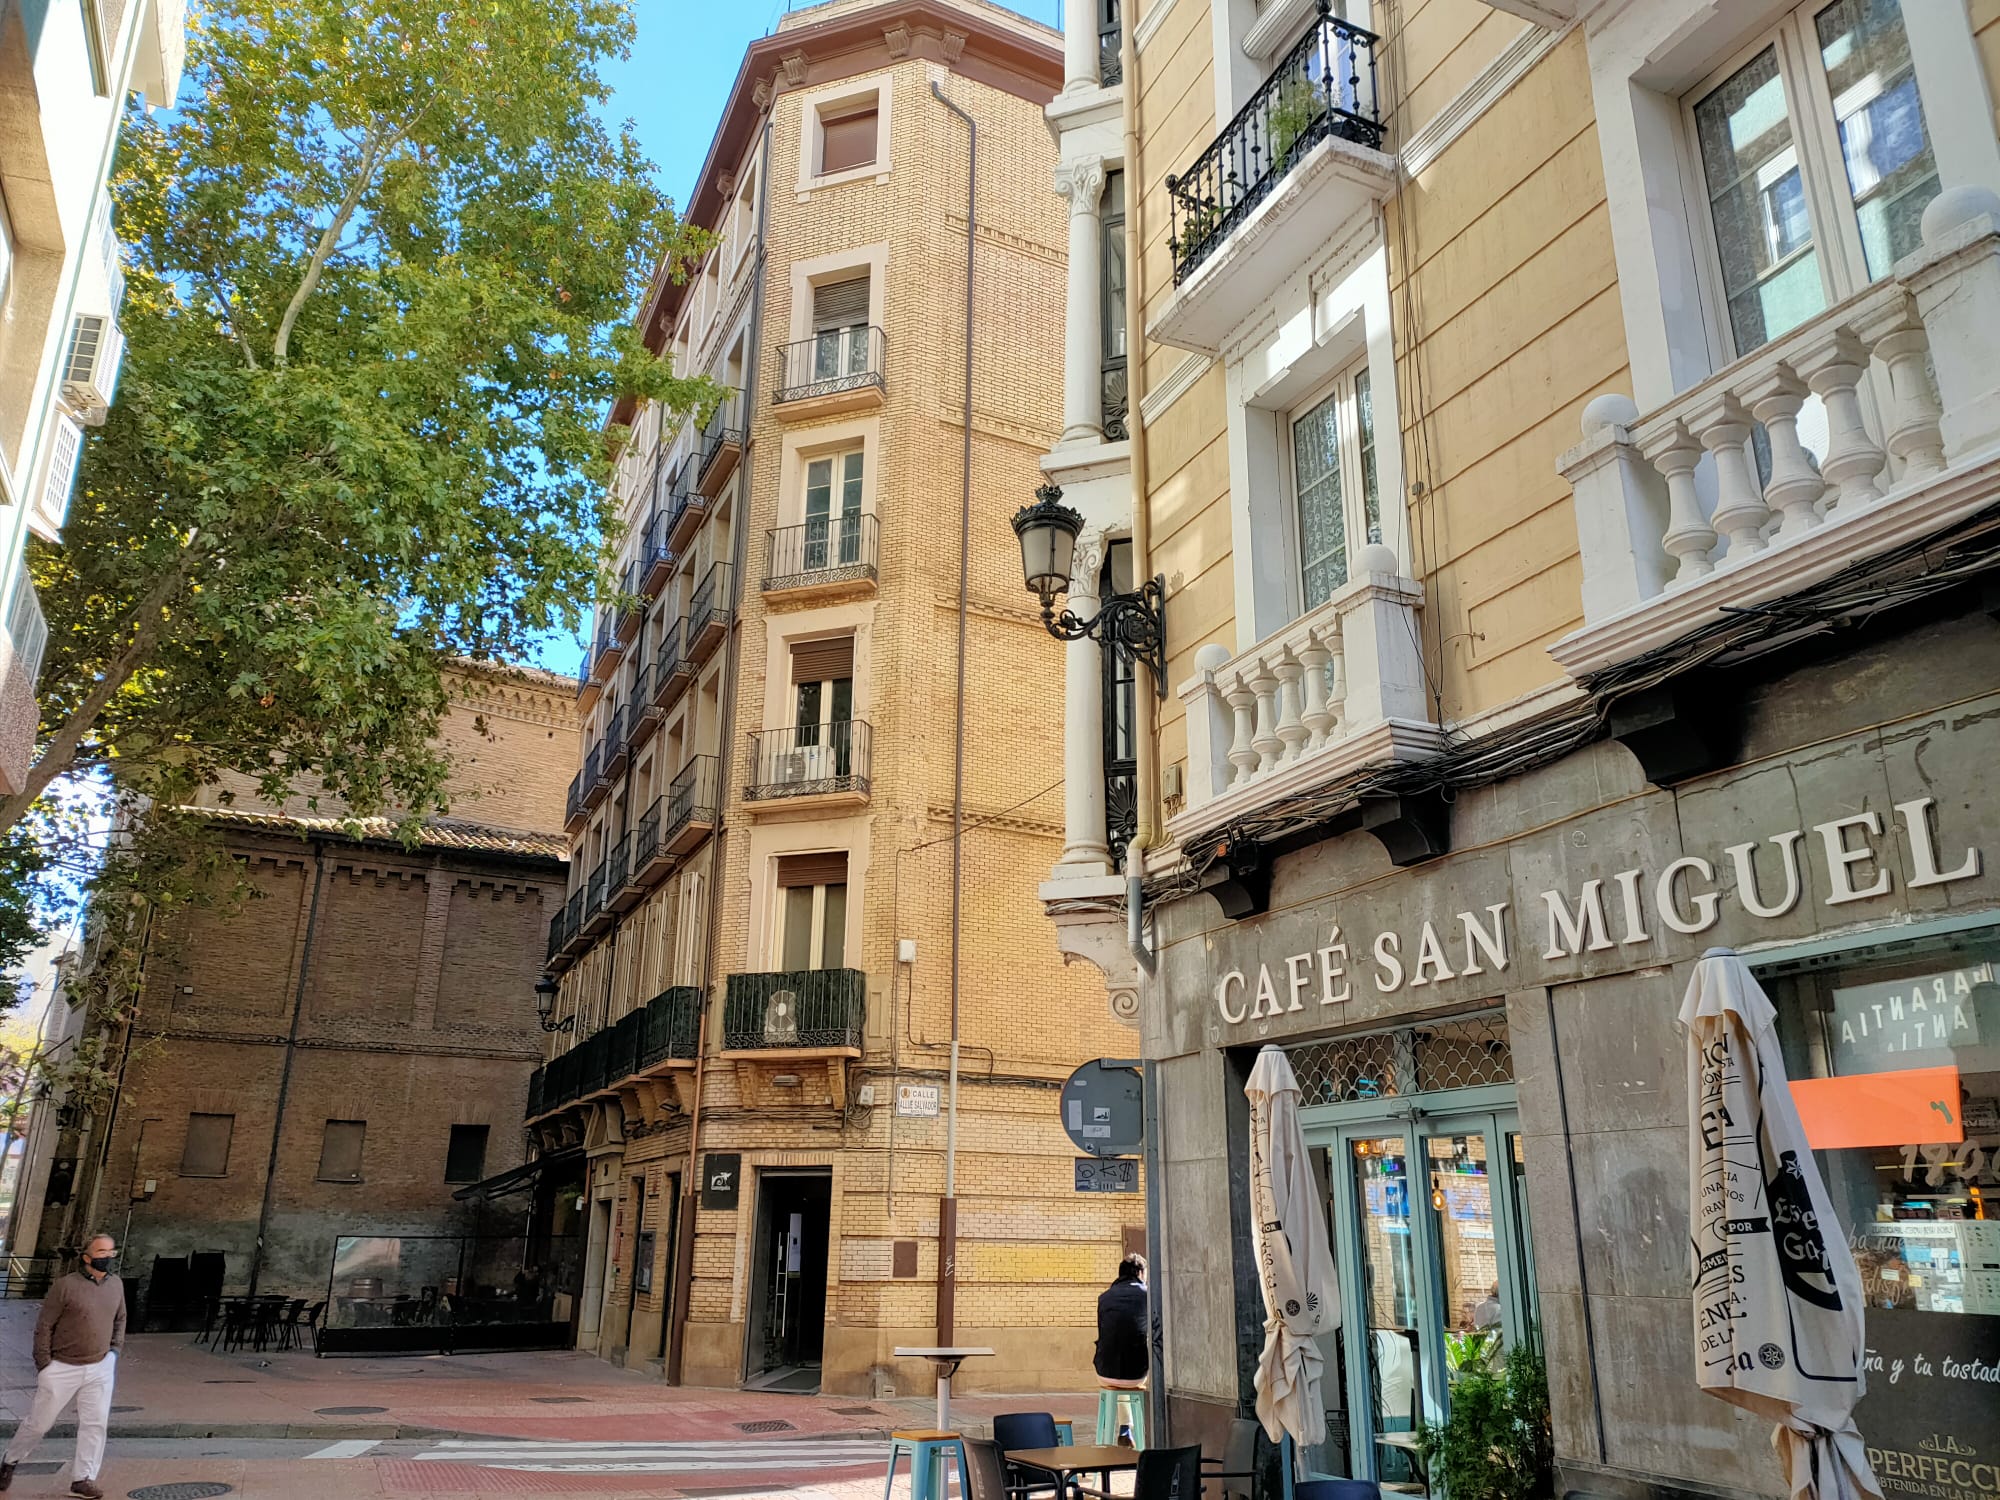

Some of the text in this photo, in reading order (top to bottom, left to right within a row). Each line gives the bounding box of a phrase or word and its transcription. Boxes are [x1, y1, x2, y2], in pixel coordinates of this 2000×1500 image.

[1218, 797, 1980, 1025] CAFÉ SAN MIGUEL
[912, 1090, 935, 1099] CALLE
[1889, 1359, 1904, 1384] y
[1914, 1353, 1933, 1376] tu
[1932, 1433, 1959, 1454] LA
[1929, 1485, 1946, 1498] EN
